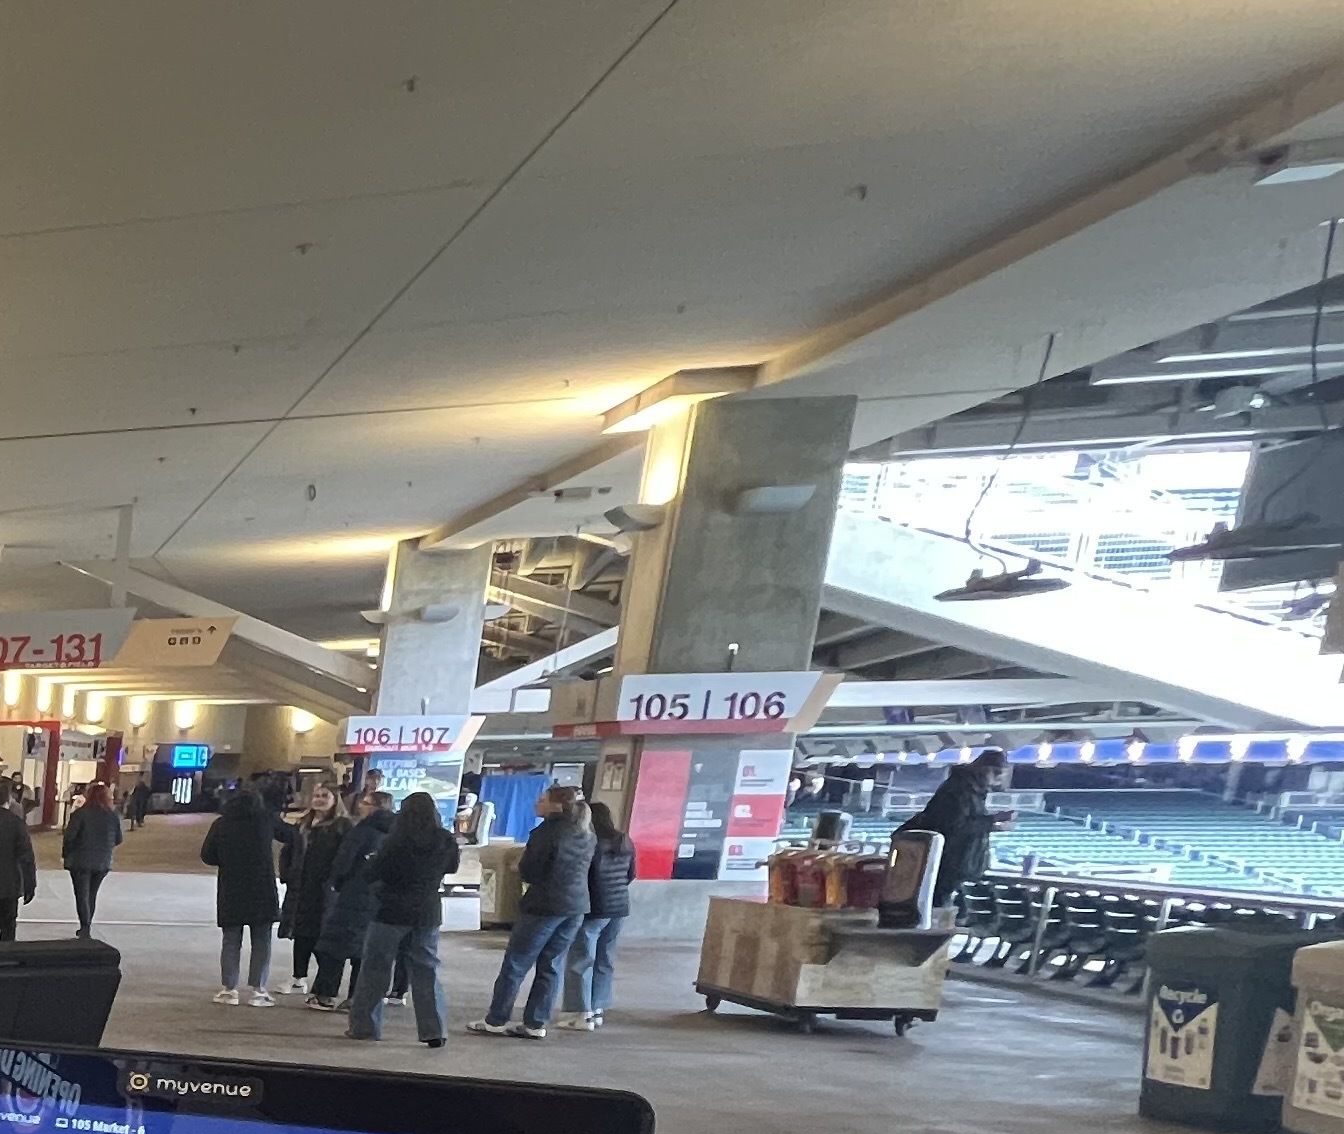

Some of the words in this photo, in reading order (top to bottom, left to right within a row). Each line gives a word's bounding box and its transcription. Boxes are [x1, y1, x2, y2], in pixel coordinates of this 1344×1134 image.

[629, 692, 691, 721] 105
[724, 690, 786, 721] 106
[354, 727, 391, 746] 106
[411, 727, 450, 746] 107
[383, 777, 419, 791] LEAN
[156, 1077, 253, 1097] myvenue
[71, 1118, 92, 1132] 105
